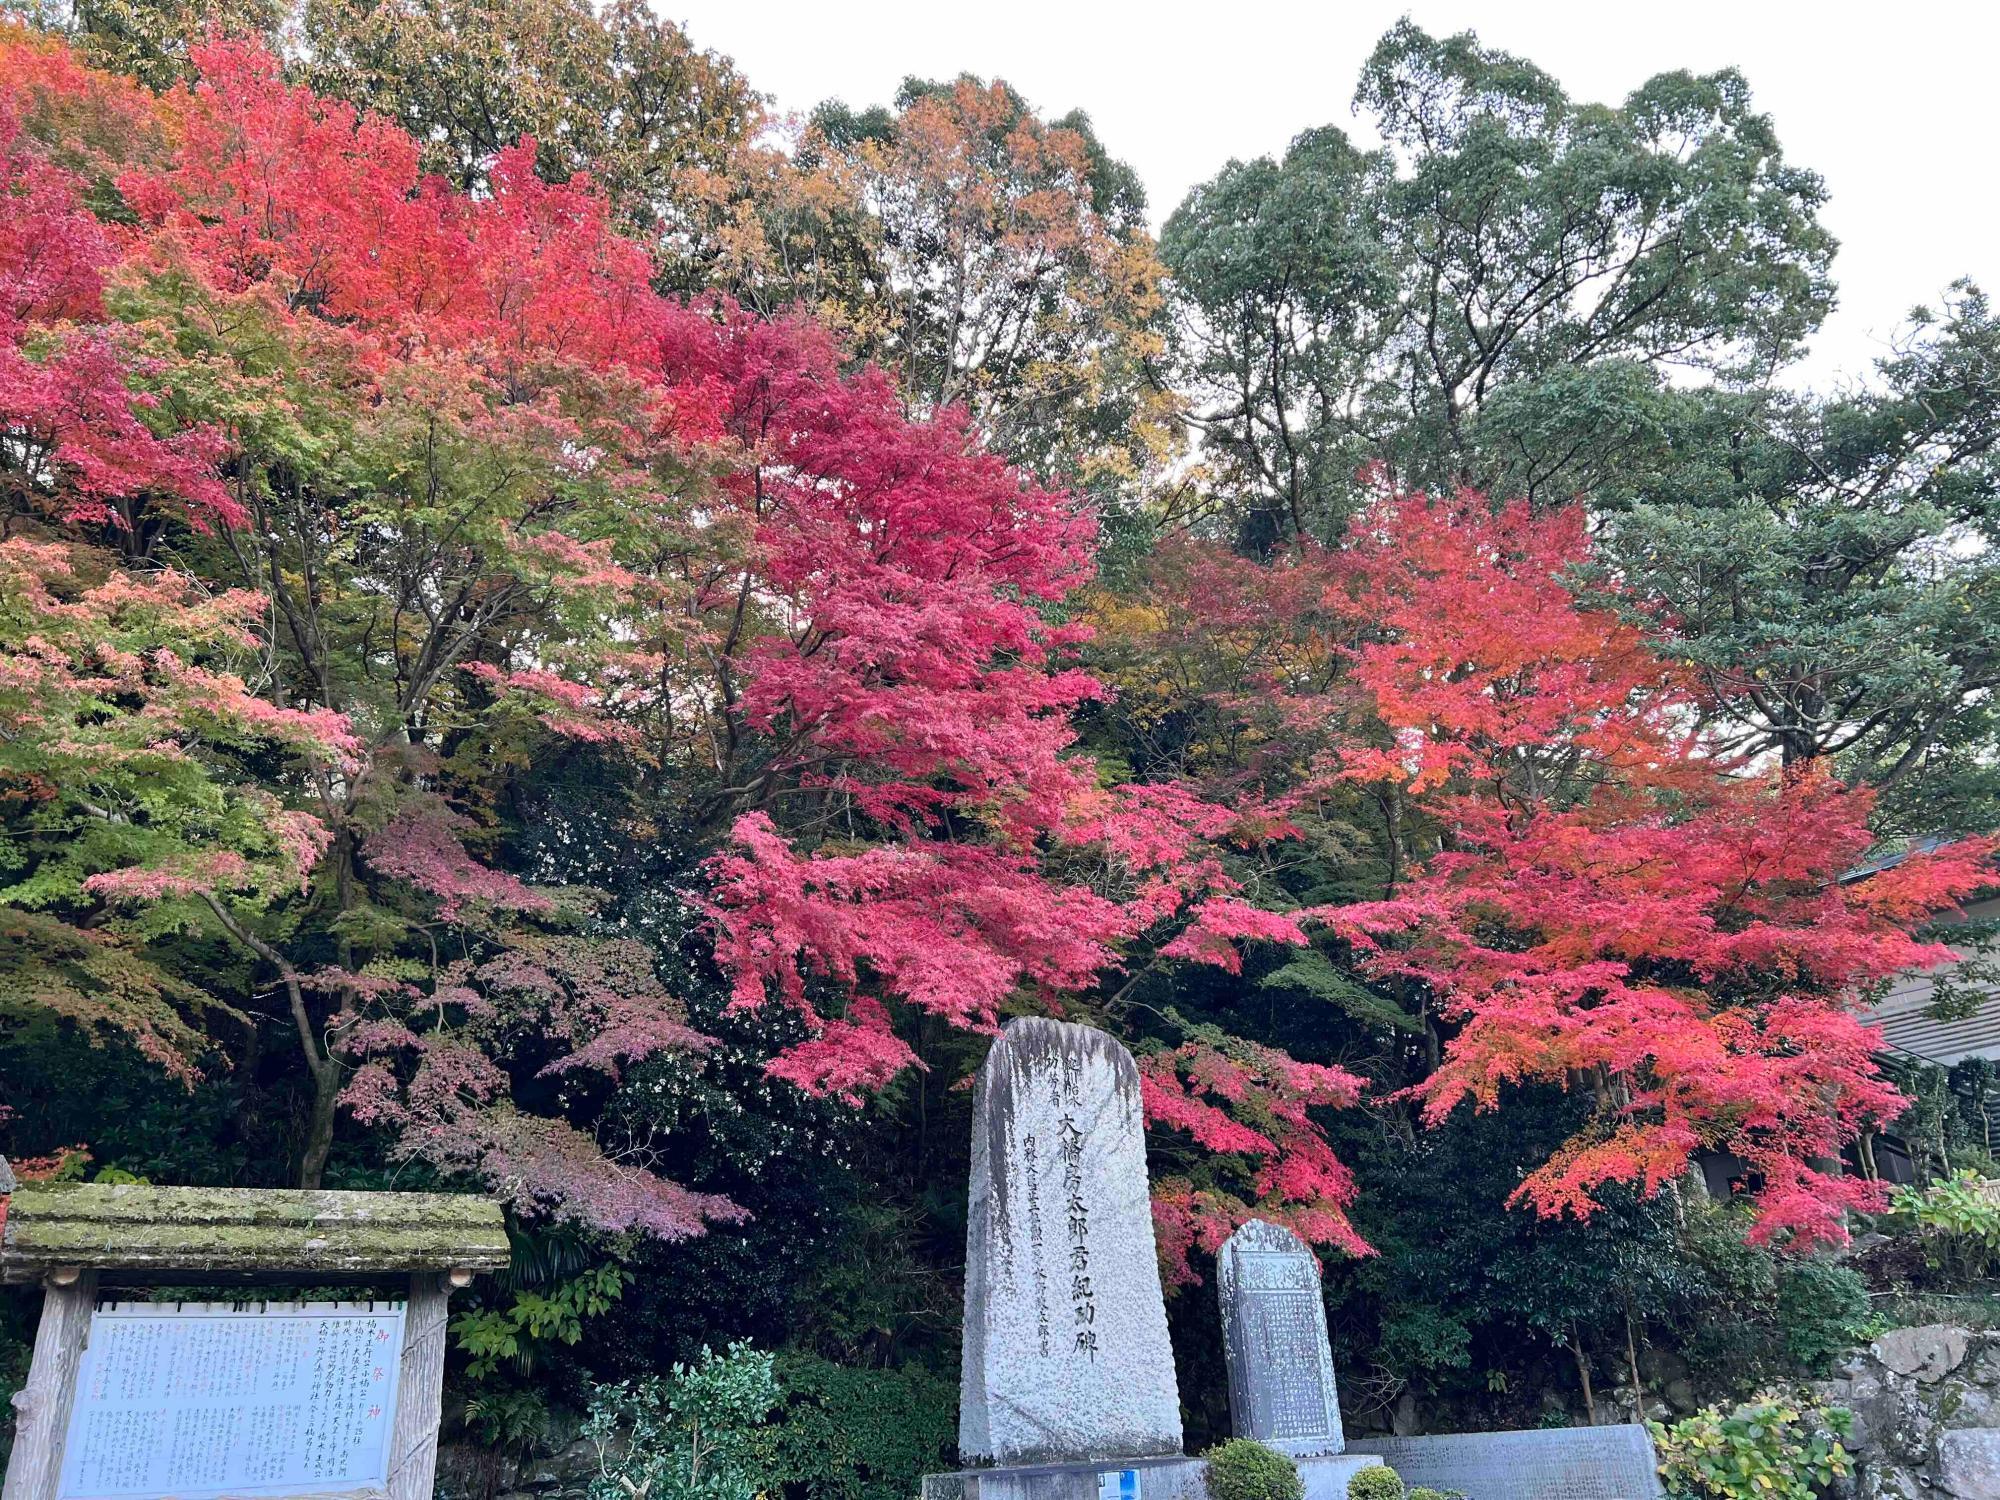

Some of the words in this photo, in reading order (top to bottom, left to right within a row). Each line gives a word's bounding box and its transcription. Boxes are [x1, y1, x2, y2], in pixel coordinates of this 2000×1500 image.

[1056, 1113, 1098, 1364] 大橋房太郎君紀功碑
